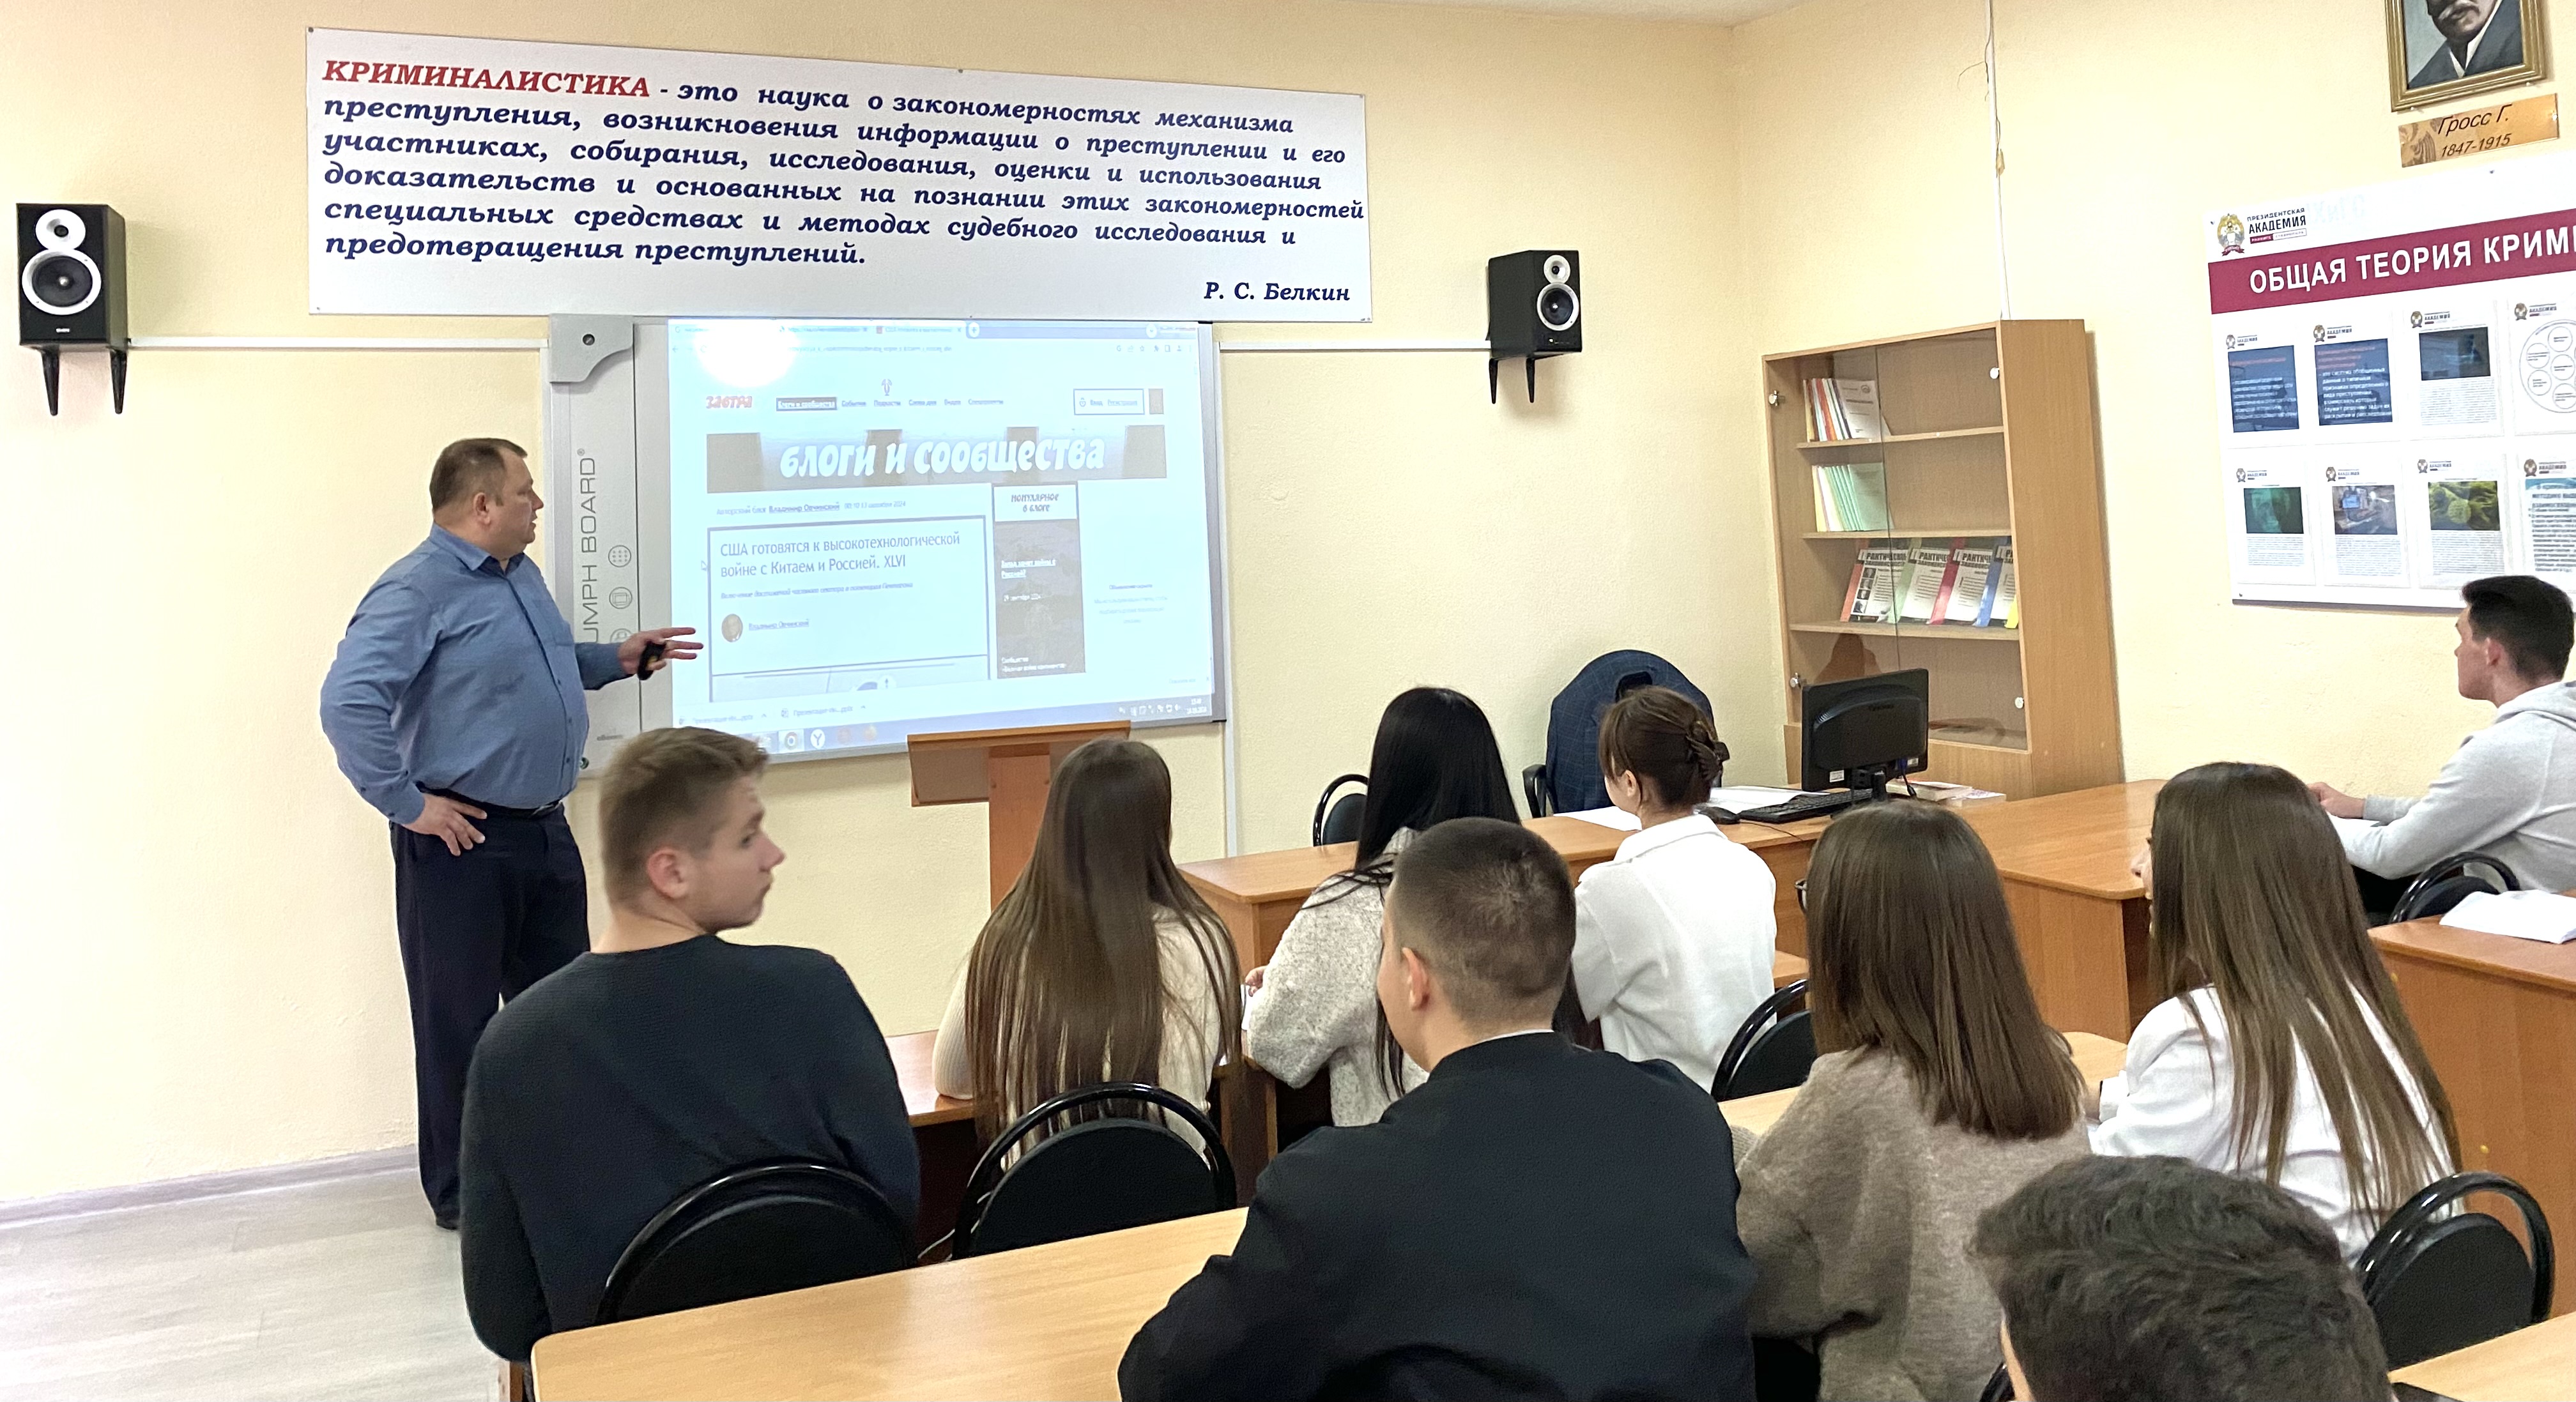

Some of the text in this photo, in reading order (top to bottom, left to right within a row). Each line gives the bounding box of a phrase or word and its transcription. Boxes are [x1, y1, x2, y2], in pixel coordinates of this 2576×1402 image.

[322, 60, 650, 97] КРИМИНАЛИСТИКА
[677, 84, 738, 102] это
[758, 89, 850, 112] наука
[868, 96, 883, 110] о
[892, 97, 1140, 125] закономерностях
[1154, 112, 1294, 133] механизма
[325, 100, 1346, 164] преступления, возникновения информации о преступлении и его
[2438, 104, 2512, 137] Гросс Г.
[322, 134, 1322, 190] участниках, собирания, исследования, оценки и использования
[2441, 133, 2512, 158] 1847-1915
[325, 160, 1364, 221] доказательств и основанных на познании этих закономерностей
[325, 203, 1296, 245] специальных средствах и методах судебного исследования и
[2246, 208, 2305, 222] ПРЕЗИДЕНТСКАЯ
[2248, 215, 2306, 234] АКАДЕМИЯ
[326, 231, 865, 267] предотвращения преступлений.
[2250, 225, 2576, 294] ОБЩАЯ ТЕОРИЯ КРИМ
[1203, 282, 1351, 301] Р. С. Белкин
[721, 531, 960, 557] США готовятся к высокотехнологической
[721, 562, 756, 577] войне
[760, 565, 767, 575] с
[771, 560, 815, 574] Китаем
[818, 561, 825, 571] и
[829, 555, 880, 570] Россией.
[581, 565, 599, 643] UMPH
